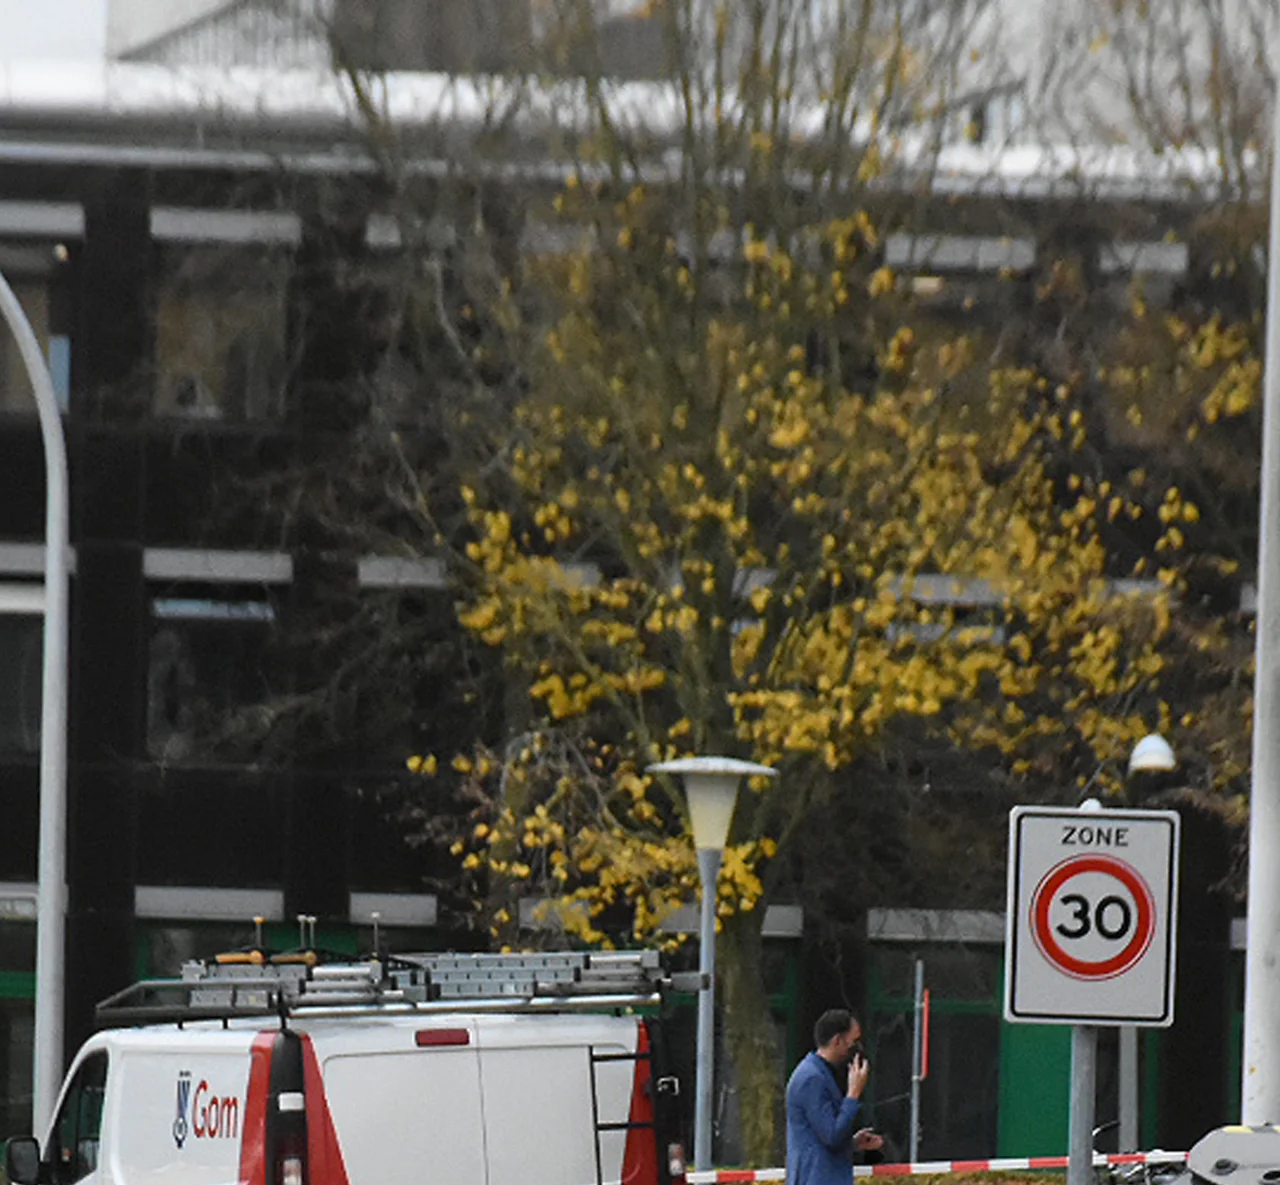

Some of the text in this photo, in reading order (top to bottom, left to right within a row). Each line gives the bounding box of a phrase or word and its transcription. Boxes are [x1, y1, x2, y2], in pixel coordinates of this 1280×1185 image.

[1061, 826, 1130, 847] ZONE
[1056, 894, 1132, 941] 30
[192, 1080, 239, 1139] Gom
